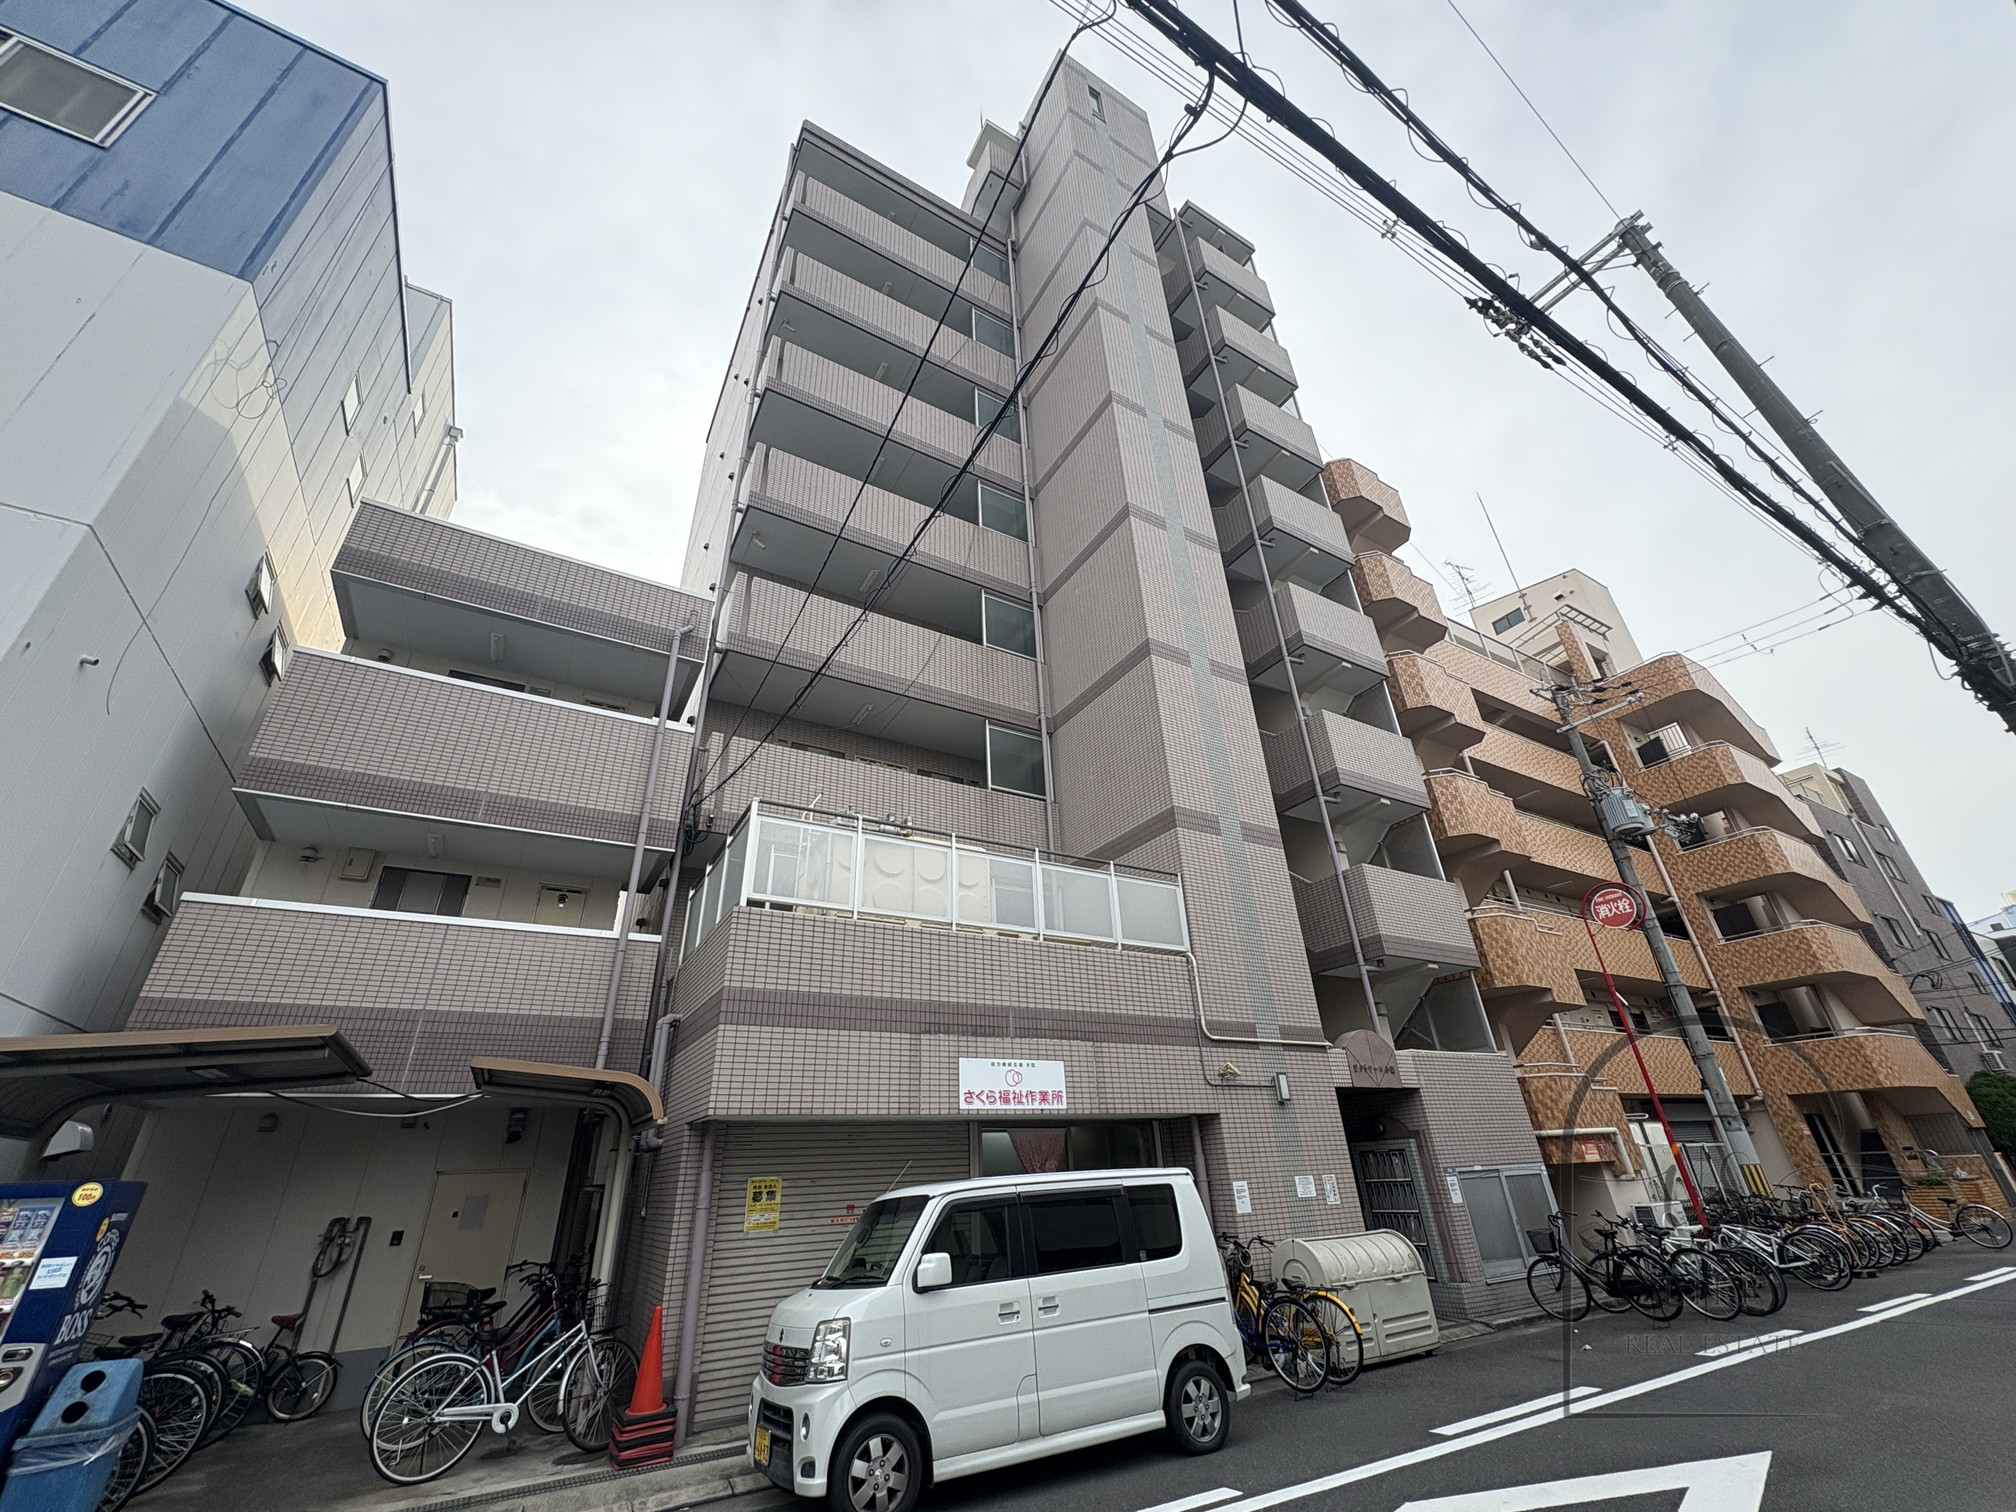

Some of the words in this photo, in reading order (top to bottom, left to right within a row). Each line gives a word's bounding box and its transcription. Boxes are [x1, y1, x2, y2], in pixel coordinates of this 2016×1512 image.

[1595, 898, 1633, 919] 消火栓
[963, 1089, 1064, 1106] さくら福祉作業所
[752, 1190, 777, 1203] 募集
[53, 1308, 93, 1345] BOSS
